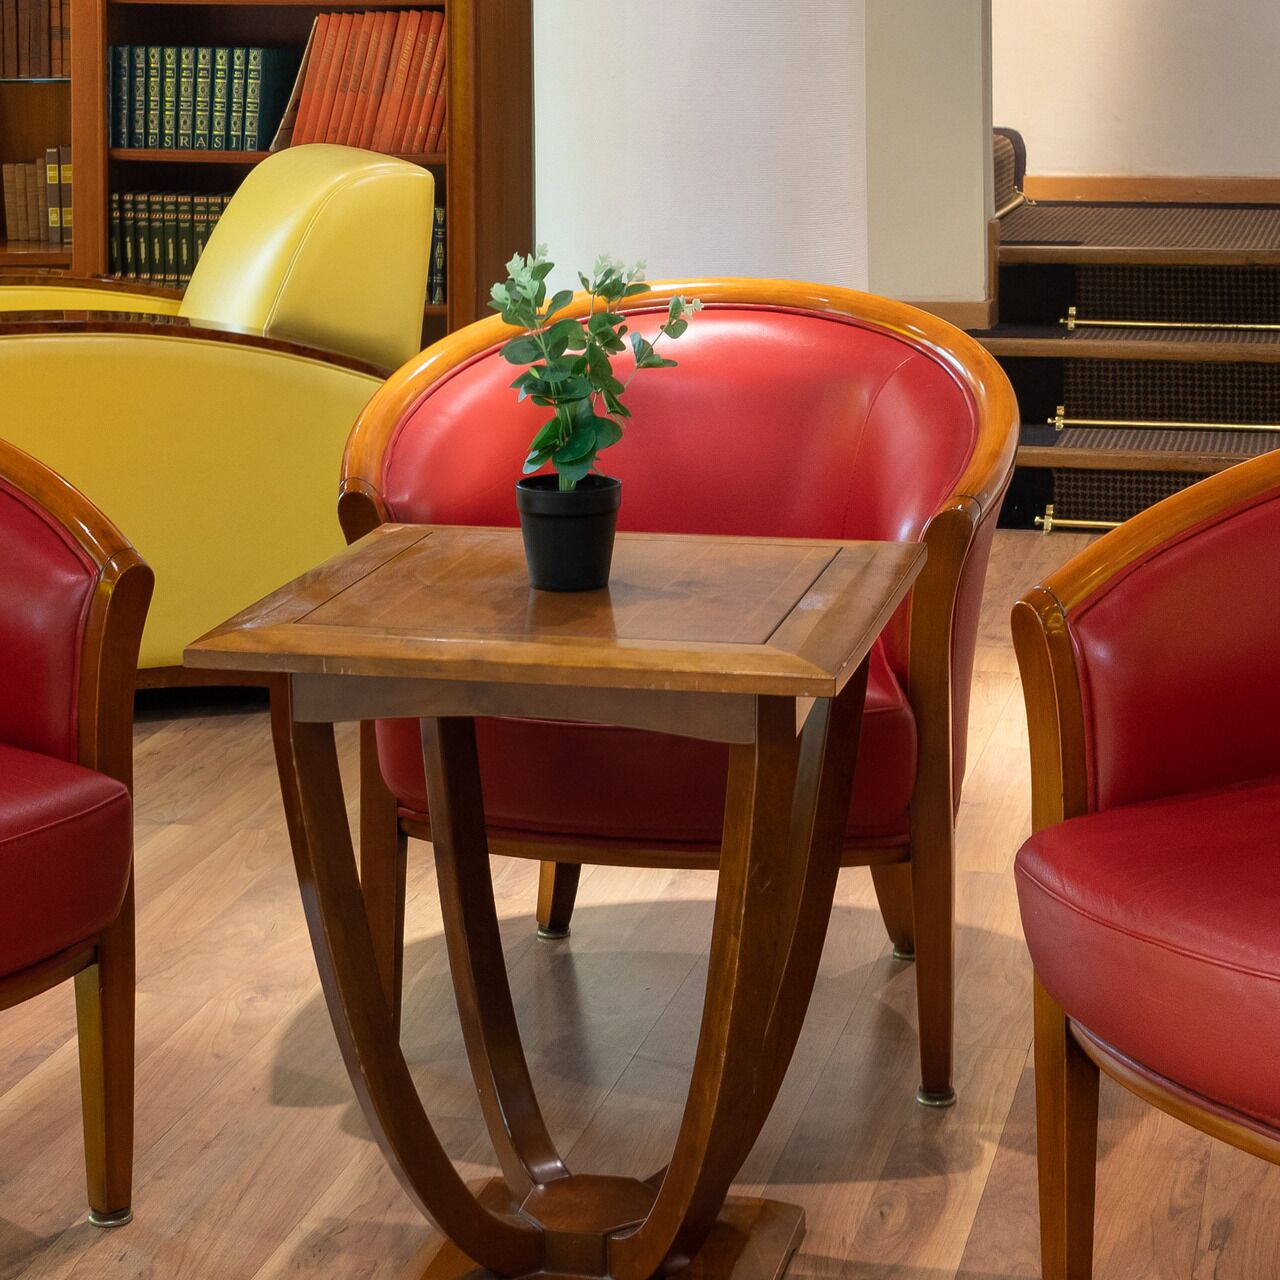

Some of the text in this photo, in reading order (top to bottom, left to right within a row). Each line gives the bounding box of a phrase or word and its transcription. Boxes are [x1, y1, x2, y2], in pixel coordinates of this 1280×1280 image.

[163, 135, 172, 147] S
[179, 135, 189, 146] R
[195, 135, 206, 147] A
[213, 135, 222, 148] S
